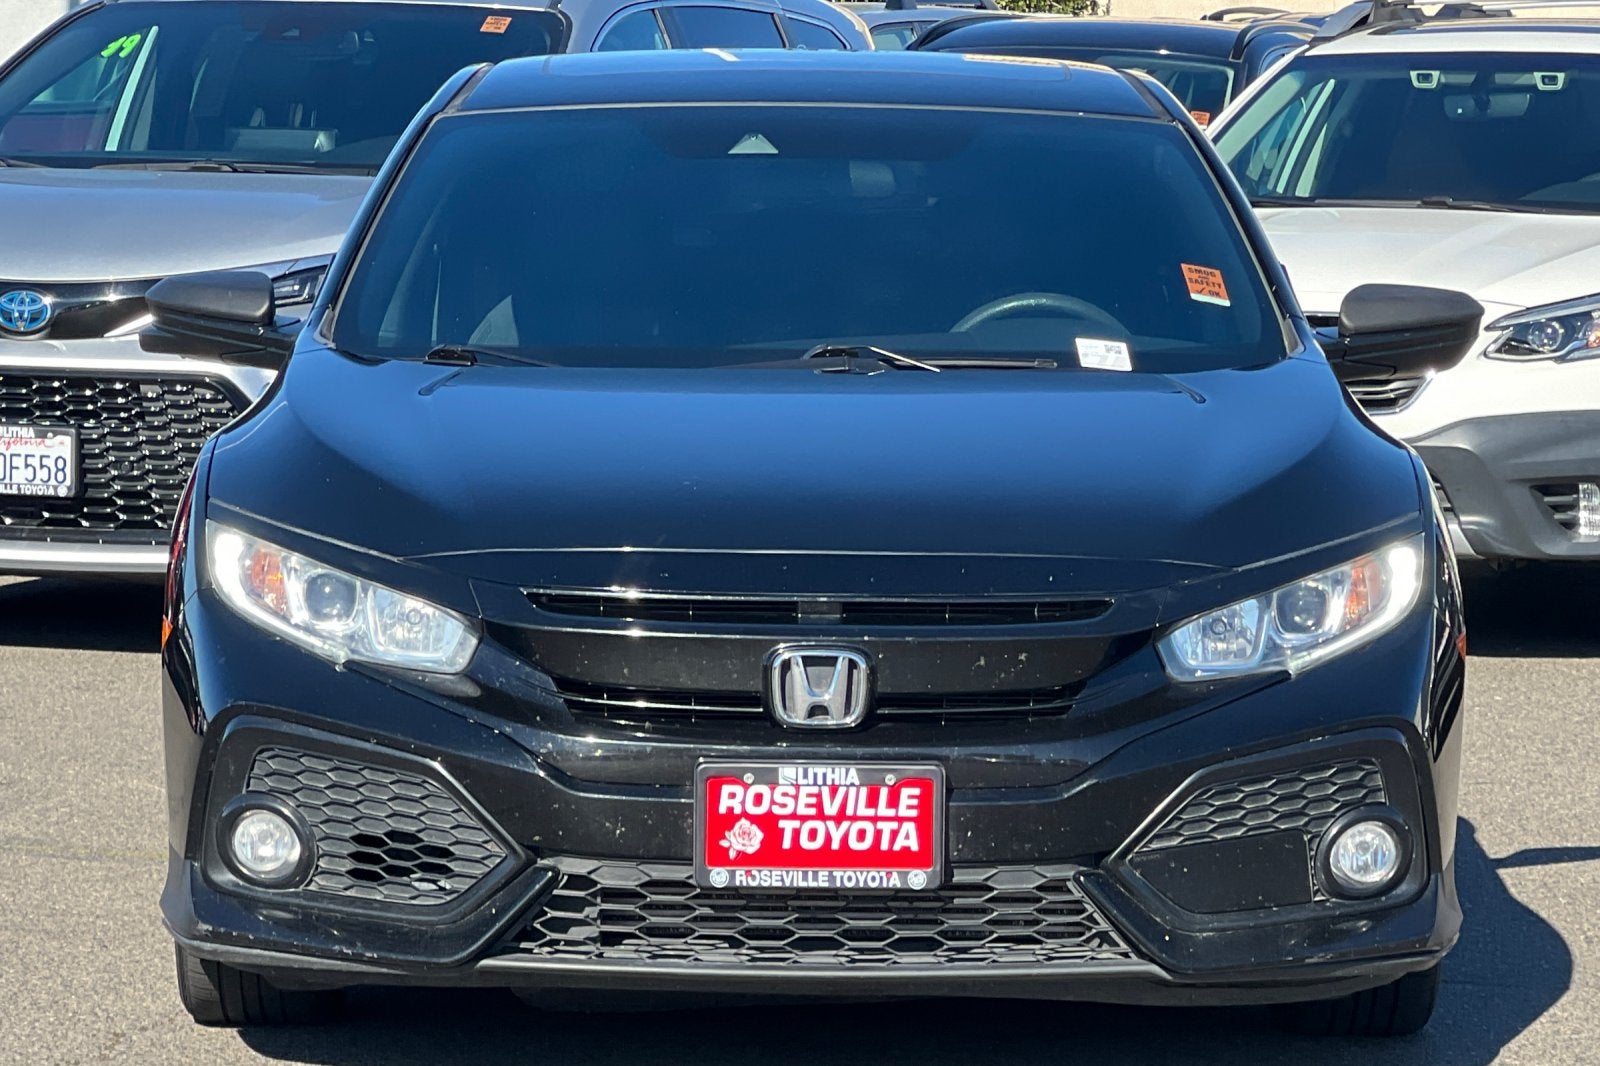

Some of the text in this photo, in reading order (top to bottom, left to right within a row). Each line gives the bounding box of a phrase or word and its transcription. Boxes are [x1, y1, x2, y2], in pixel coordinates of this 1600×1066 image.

[1187, 267, 1217, 278] SMOG
[1187, 277, 1222, 289] SAFETY
[3, 426, 36, 438] LITHIA
[20, 484, 55, 496] TOYOTA
[797, 767, 860, 786] LITHIA
[718, 784, 921, 818] ROSEVILLE
[778, 819, 919, 852] TOYOTA
[735, 870, 901, 888] ROSEVILLE TOYOTA
